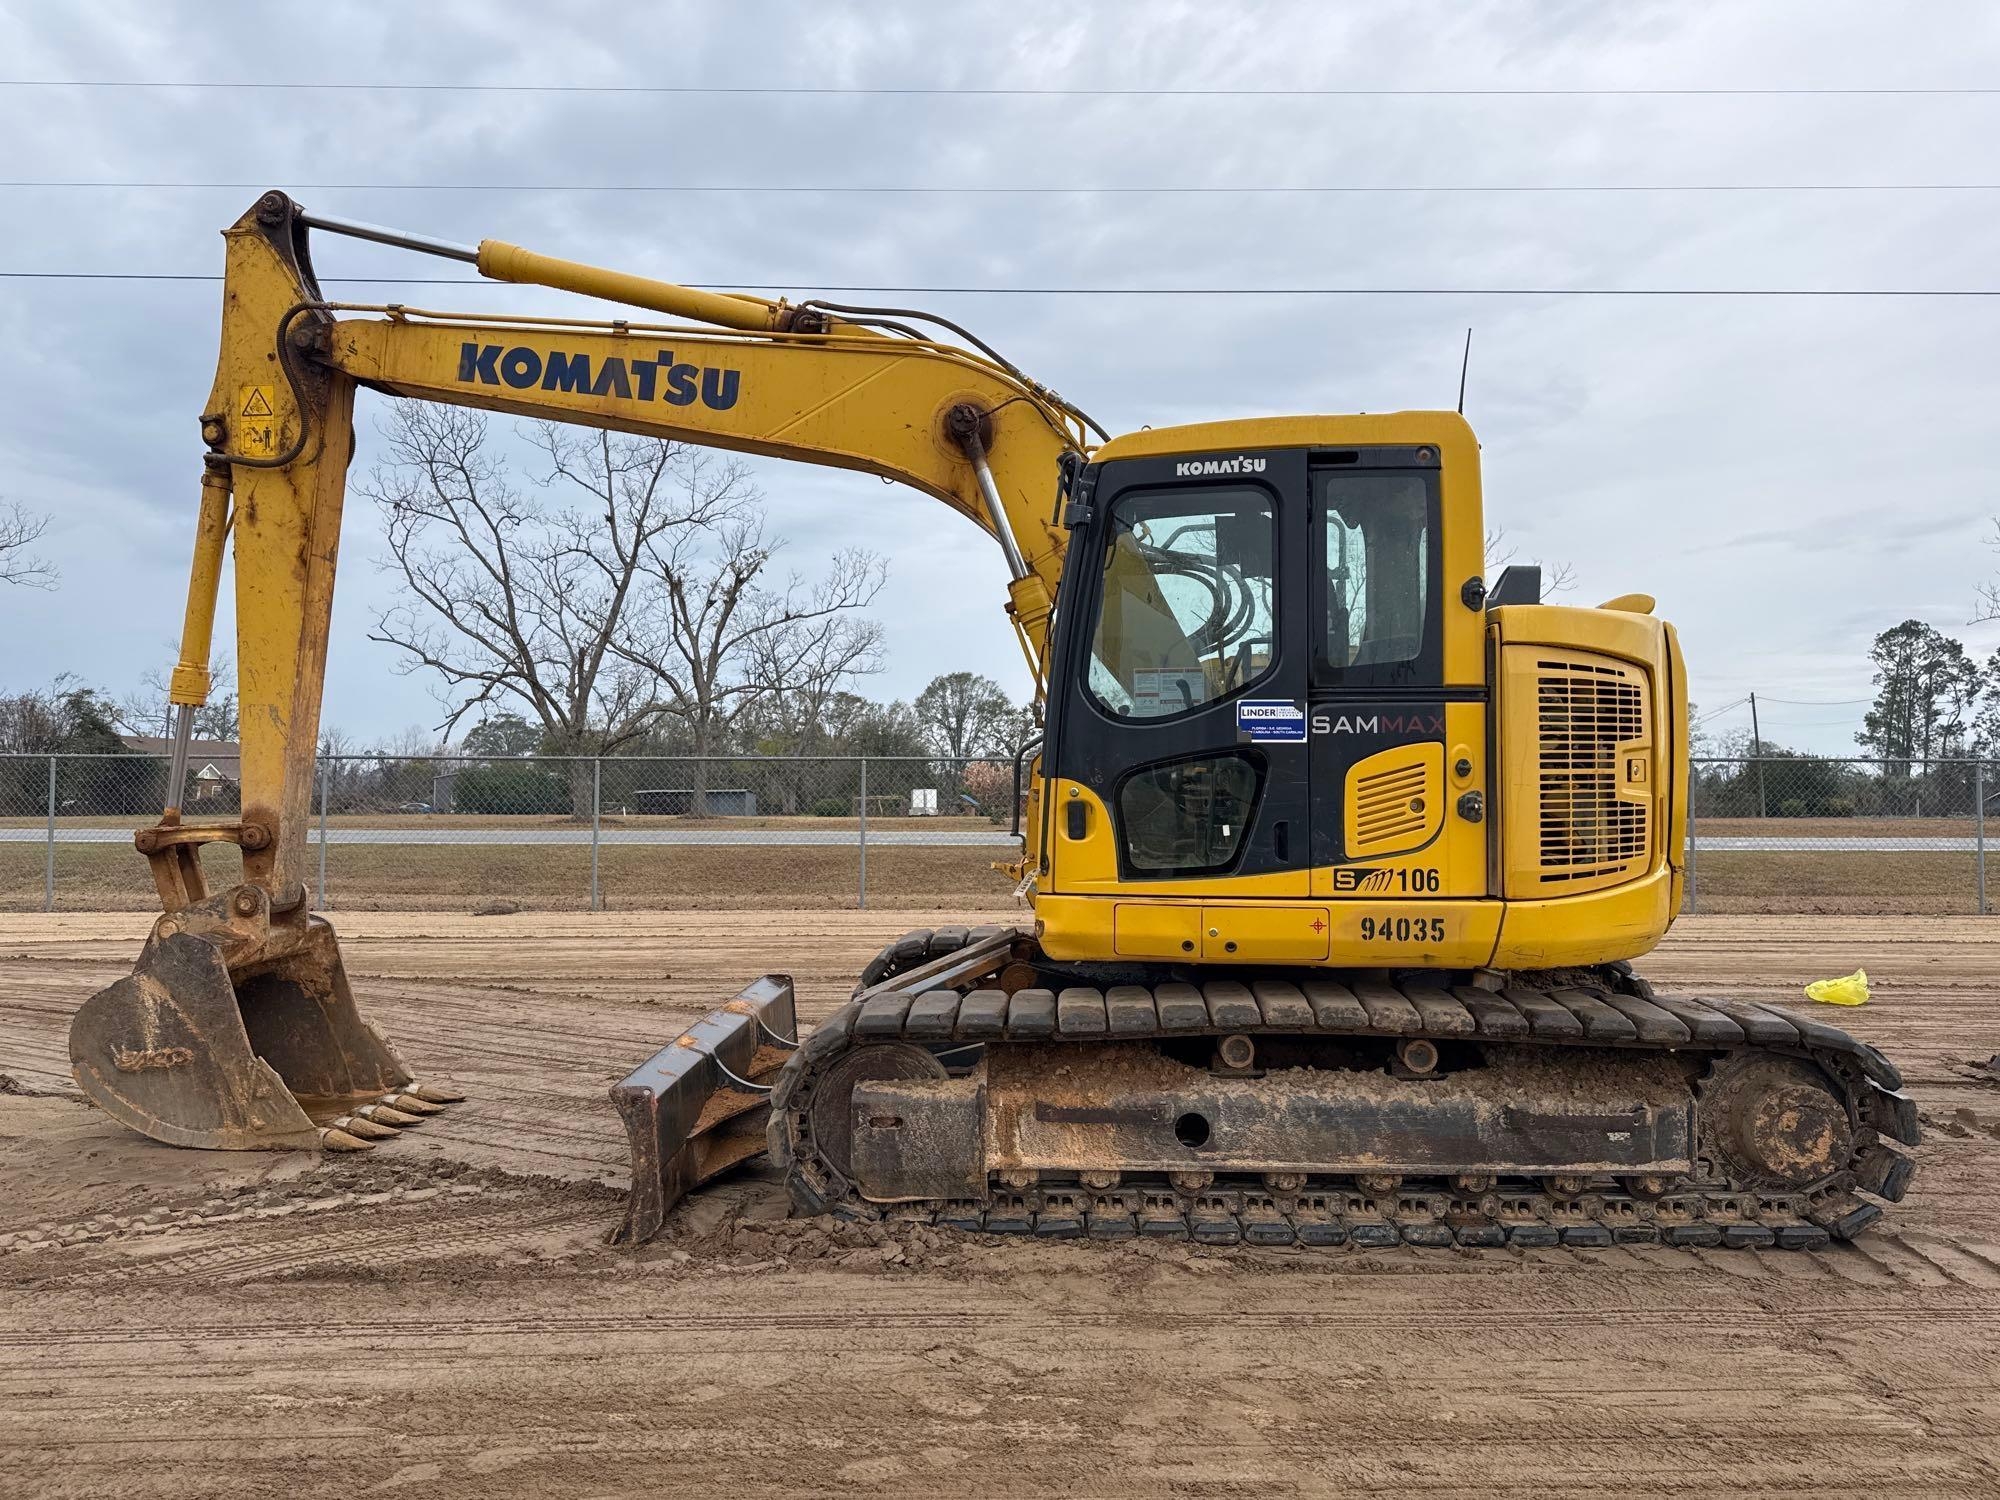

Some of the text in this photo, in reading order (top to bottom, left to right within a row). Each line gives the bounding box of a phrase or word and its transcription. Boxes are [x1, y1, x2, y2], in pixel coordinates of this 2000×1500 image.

[458, 342, 741, 411] KOMATSU
[1176, 456, 1266, 476] KOMATSU
[1242, 709, 1276, 717] LINDER
[1311, 715, 1446, 734] SAMMAX
[1396, 868, 1440, 892] 106
[1361, 917, 1445, 942] 94035
